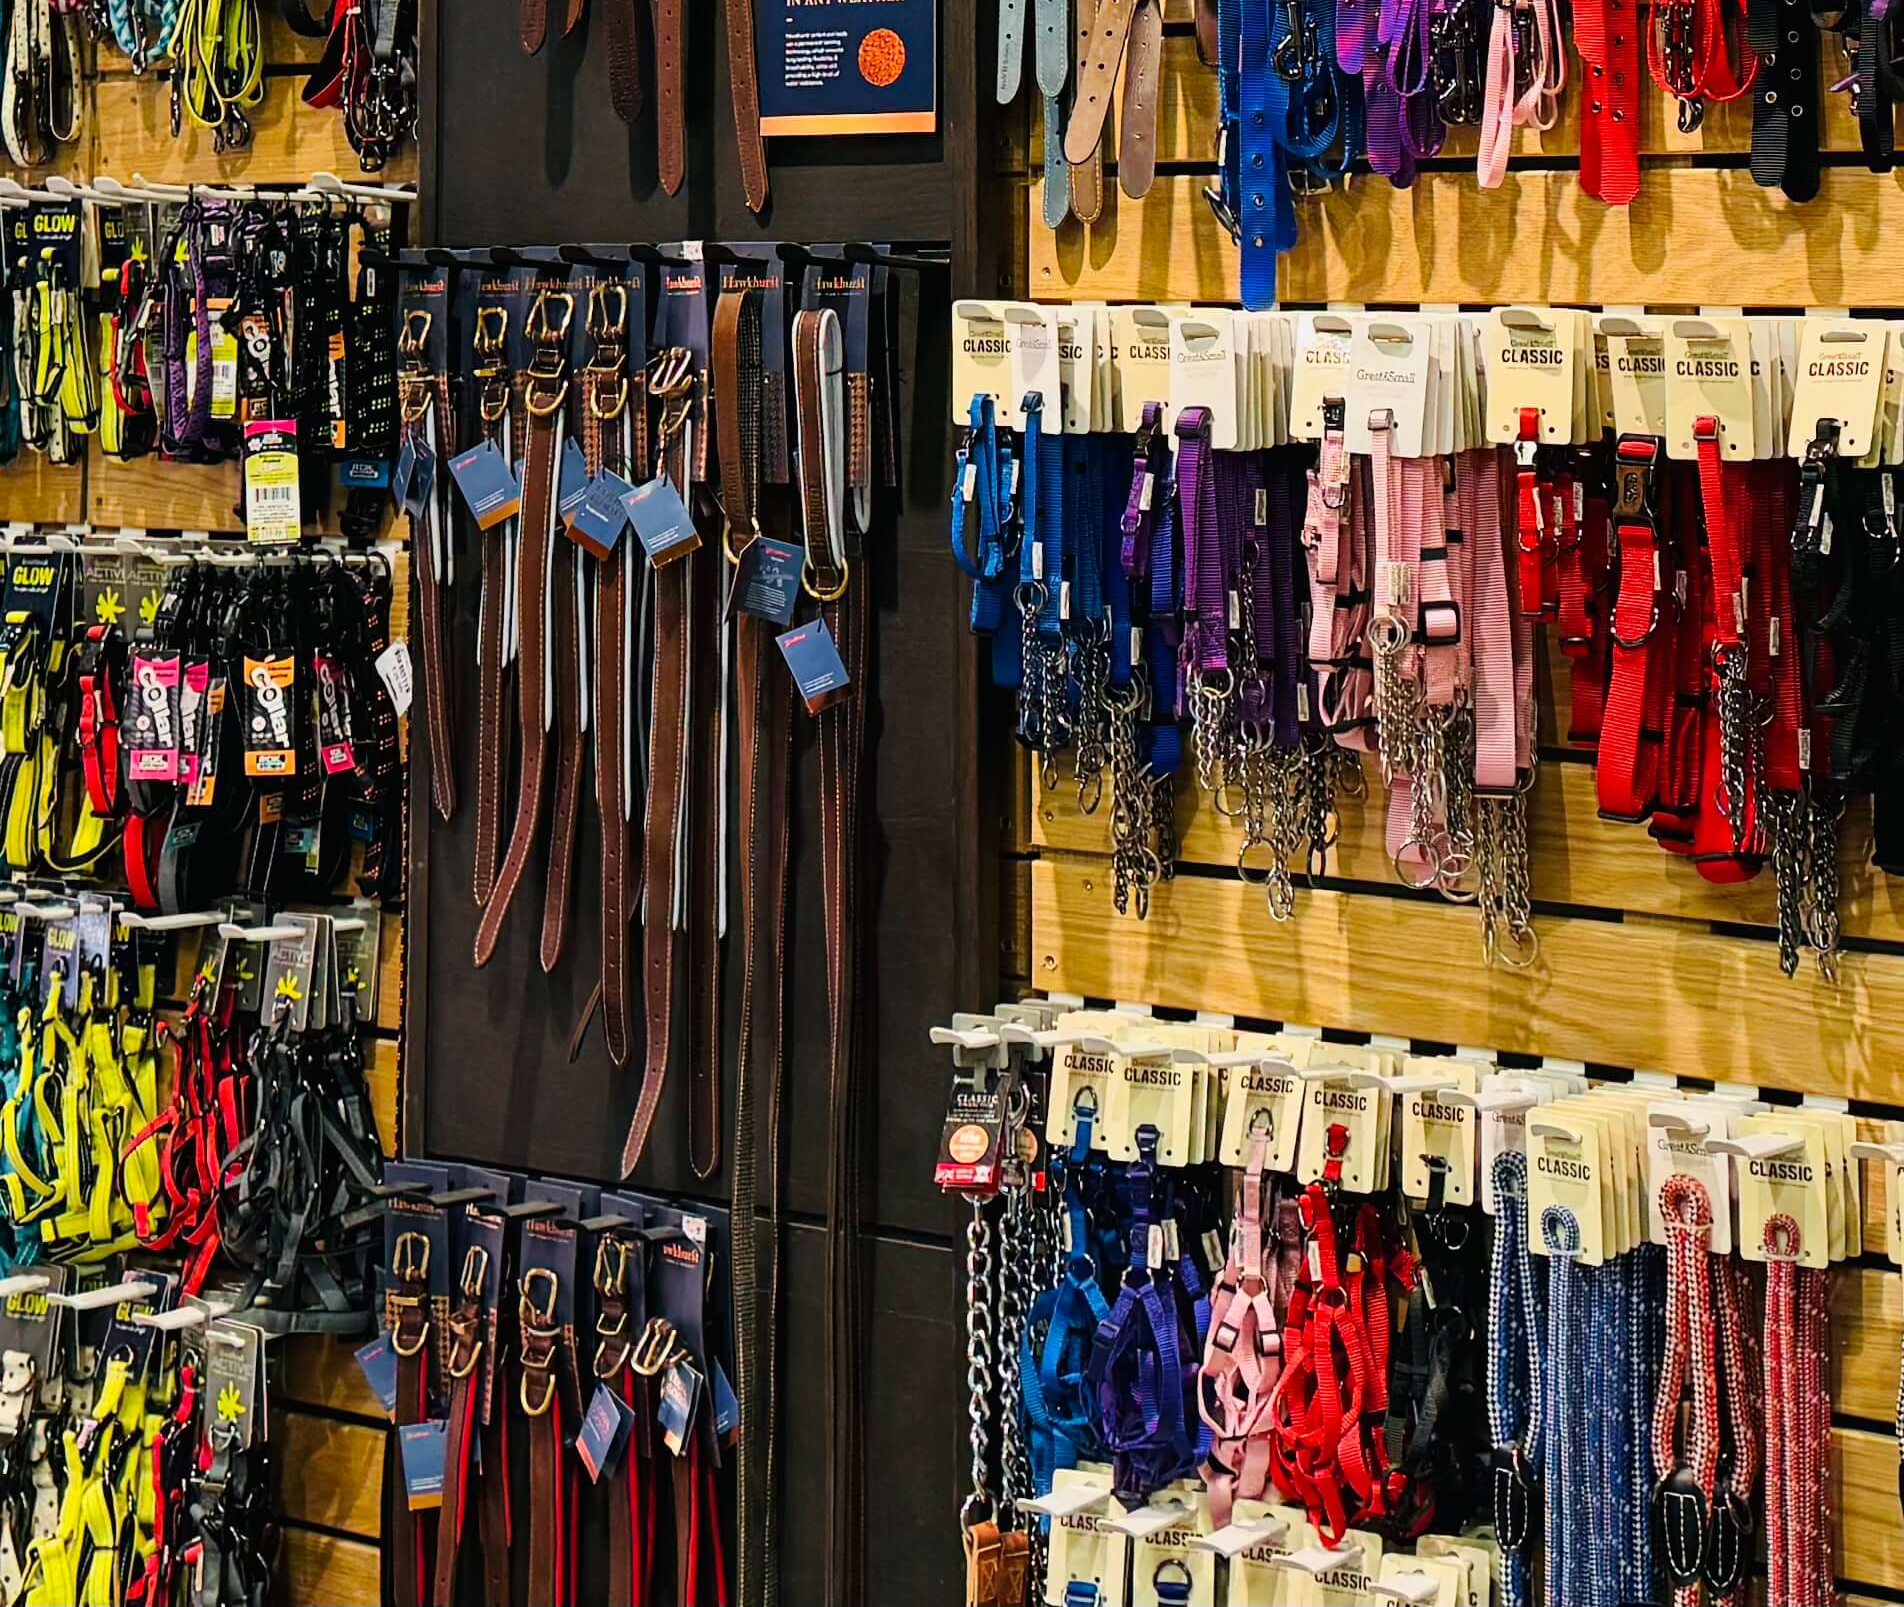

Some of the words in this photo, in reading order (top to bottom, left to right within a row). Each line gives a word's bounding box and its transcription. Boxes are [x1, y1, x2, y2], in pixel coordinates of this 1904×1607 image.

[34, 214, 75, 233] GLOW
[1501, 349, 1564, 365] CLASSIC
[1357, 369, 1417, 385] Great&Small
[1676, 361, 1739, 378] CLASSIC
[1808, 361, 1870, 377] CLASSIC
[12, 566, 55, 586] GLOW
[1124, 1067, 1182, 1086] CLASSIC
[1240, 1075, 1294, 1094] CLASSIC
[1314, 1090, 1367, 1111] CLASSIC
[1412, 1102, 1465, 1124] CLASSIC
[1537, 1156, 1592, 1180] CLASSIC
[1750, 1161, 1813, 1182] CLASSIC
